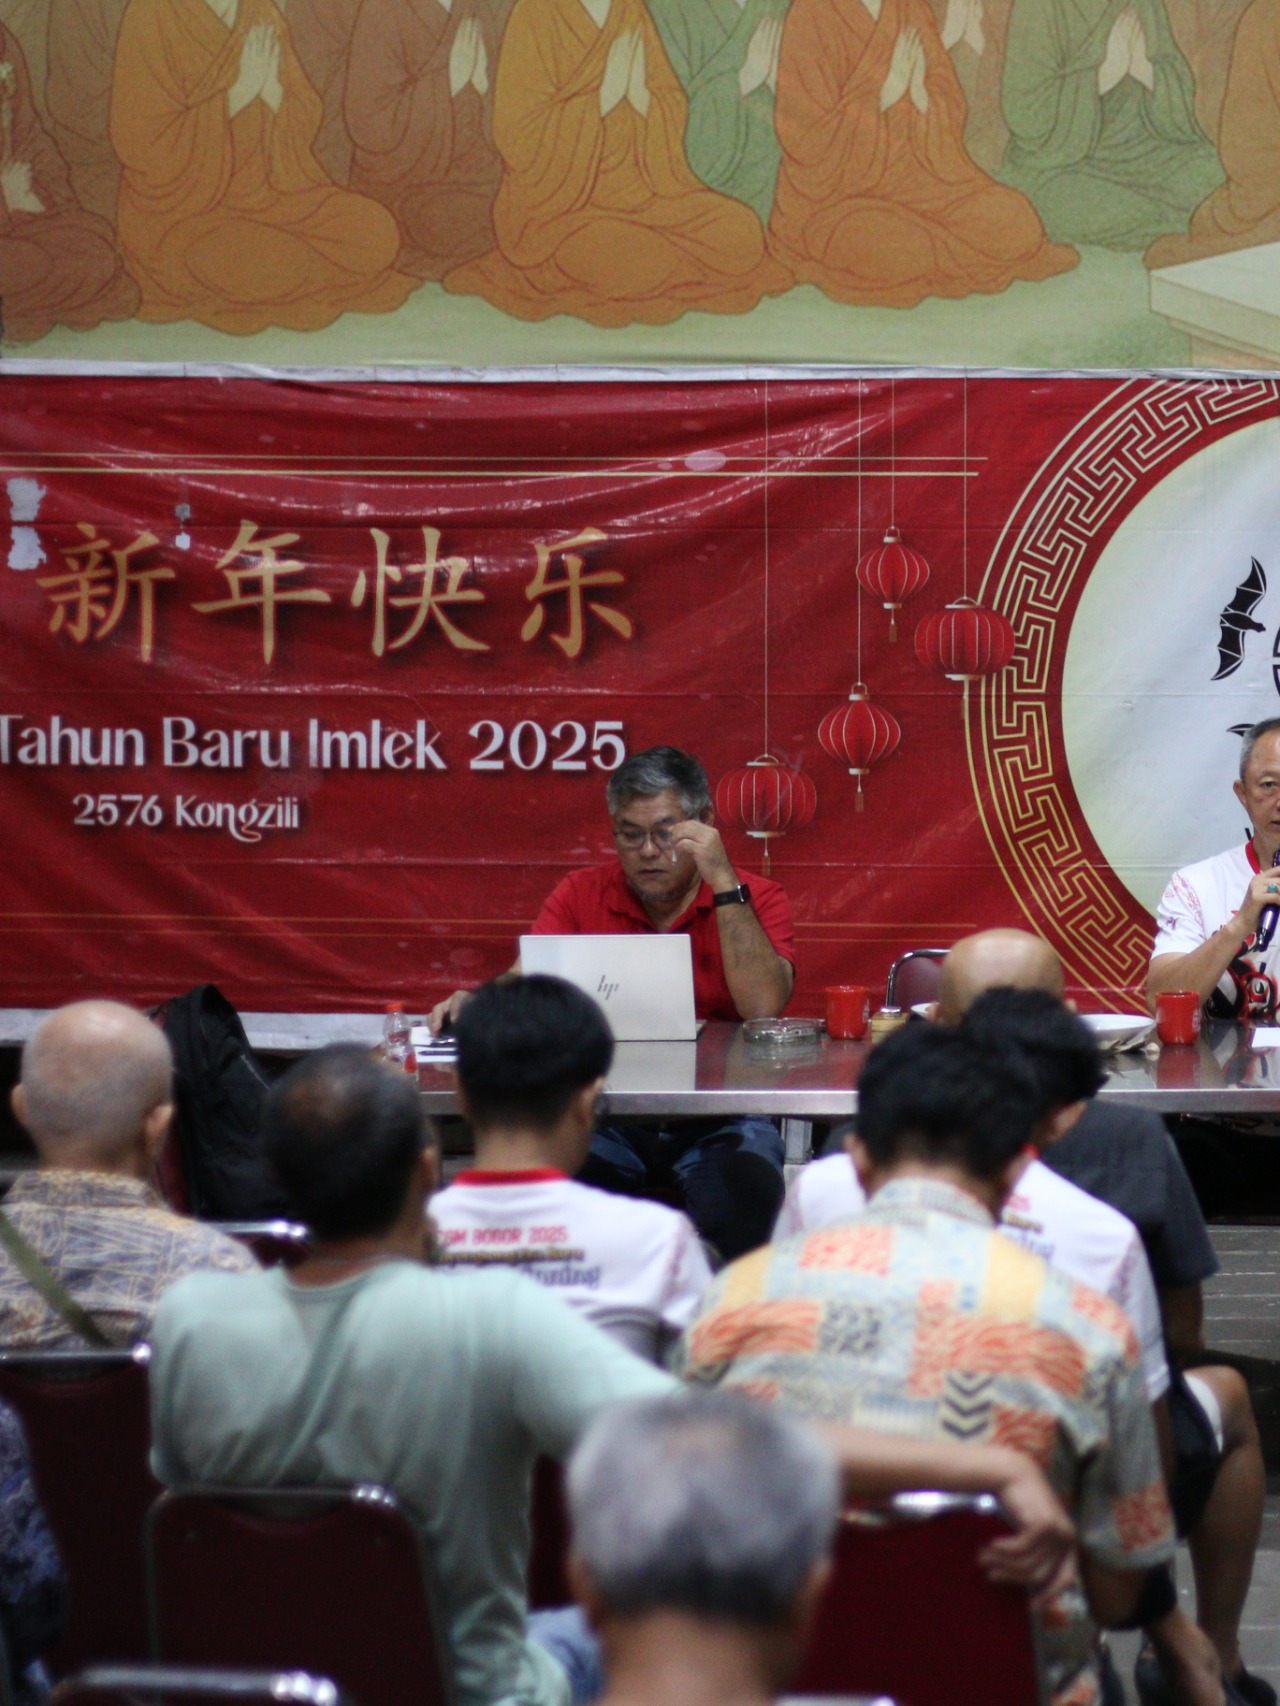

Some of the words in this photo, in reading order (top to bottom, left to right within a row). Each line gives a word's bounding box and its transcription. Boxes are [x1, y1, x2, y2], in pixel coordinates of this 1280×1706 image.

[36, 519, 634, 665] 新年快乐
[0, 714, 145, 767] Tahun
[163, 716, 290, 768] Baru
[309, 718, 447, 770] Imlek
[468, 719, 626, 771] 2025
[73, 793, 163, 826] 2576
[175, 794, 299, 843] Kongzili
